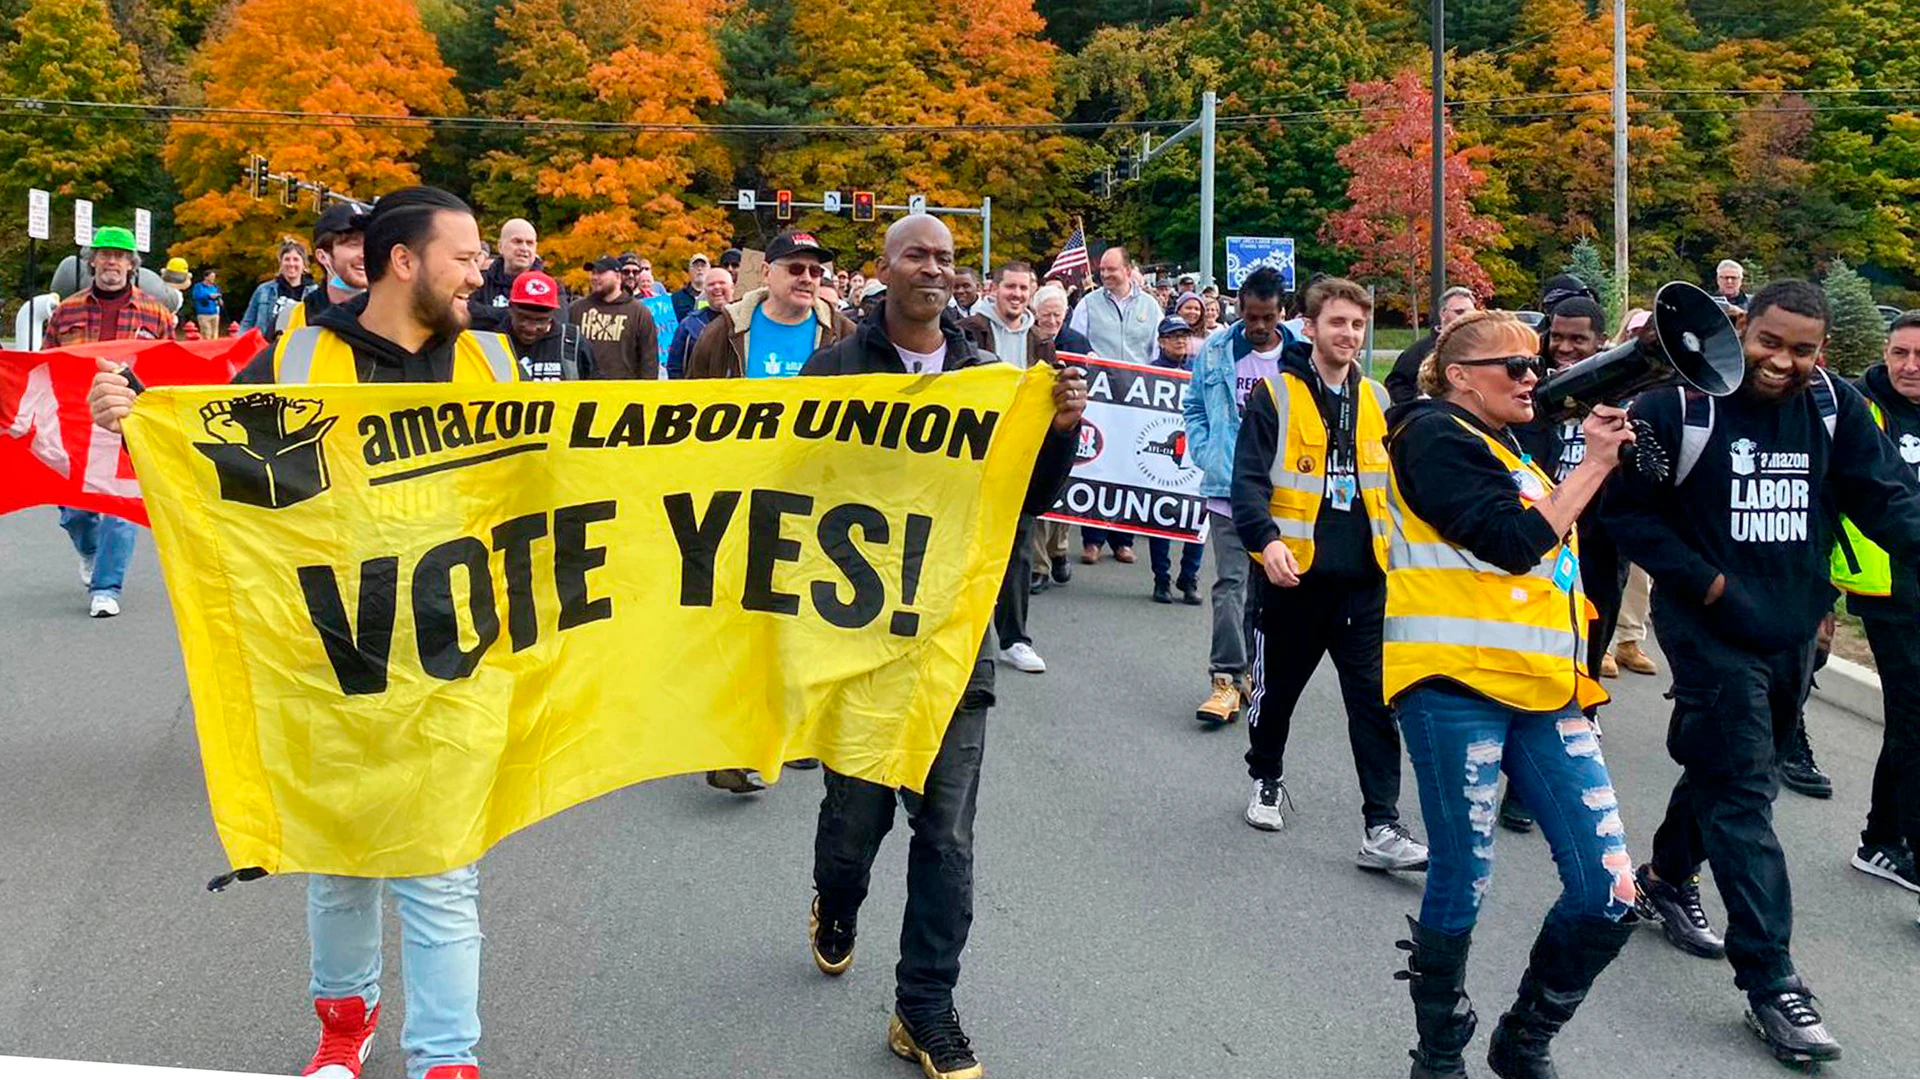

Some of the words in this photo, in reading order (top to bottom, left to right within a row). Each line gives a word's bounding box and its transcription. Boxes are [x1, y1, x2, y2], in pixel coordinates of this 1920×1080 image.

[358, 400, 555, 467] amazon
[568, 402, 785, 448] LABOR
[793, 400, 1000, 461] UNION
[1053, 482, 1206, 531] OUNCIL
[1730, 479, 1810, 510] LABOR
[1731, 511, 1808, 543] UNION
[297, 500, 617, 695] VOTE
[663, 489, 932, 638] YES!
